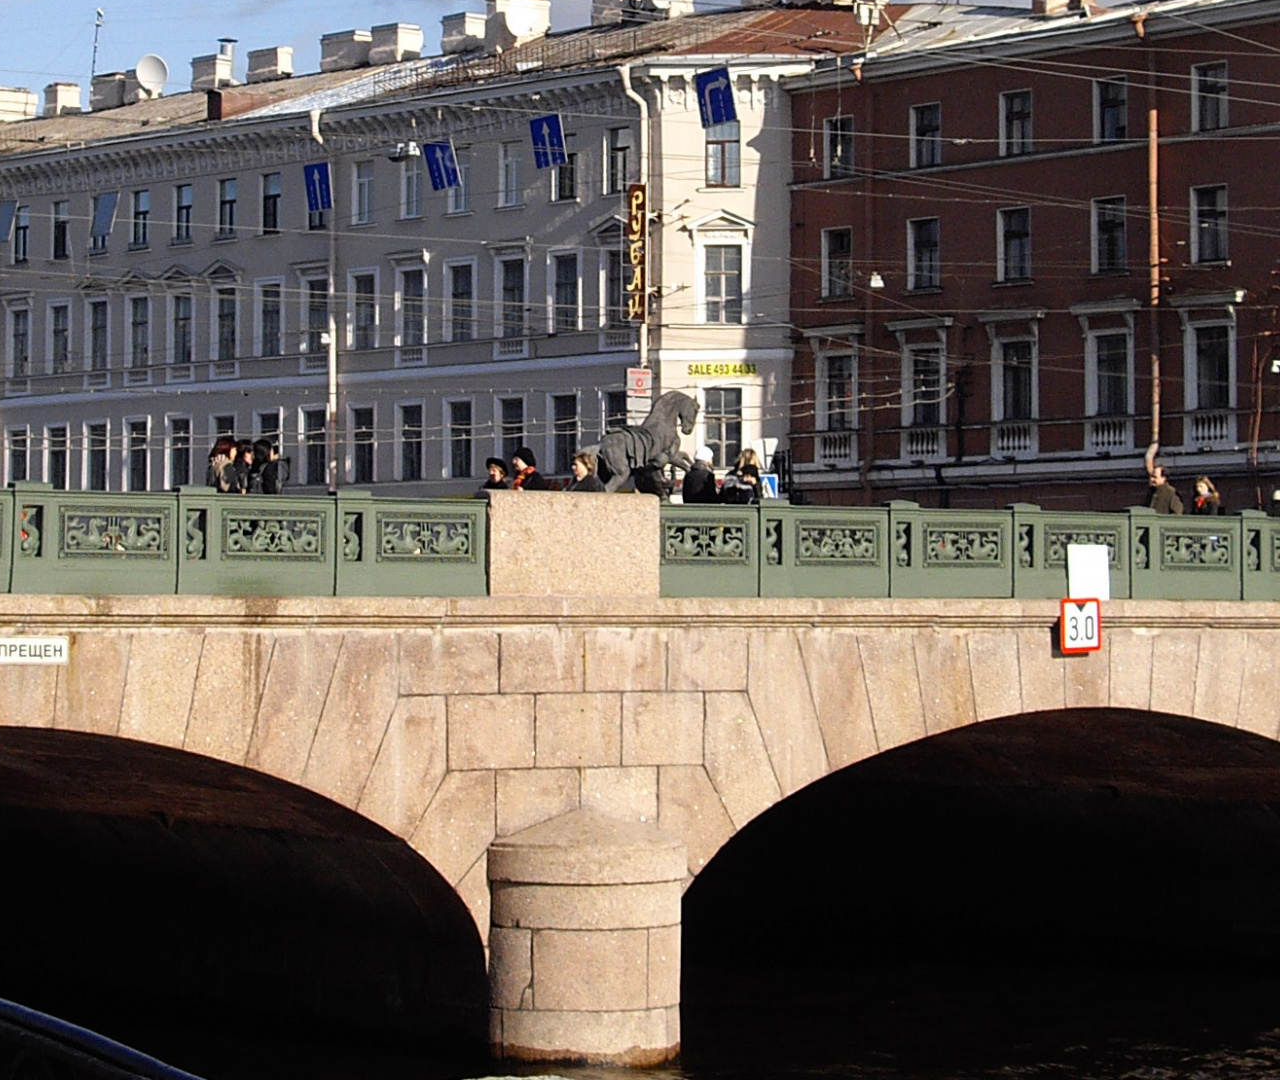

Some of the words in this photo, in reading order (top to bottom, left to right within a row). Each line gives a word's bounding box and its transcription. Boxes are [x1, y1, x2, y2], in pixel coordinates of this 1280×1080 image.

[687, 364, 712, 375] SALE
[713, 364, 730, 375] 493
[1069, 616, 1094, 641] 3.0
